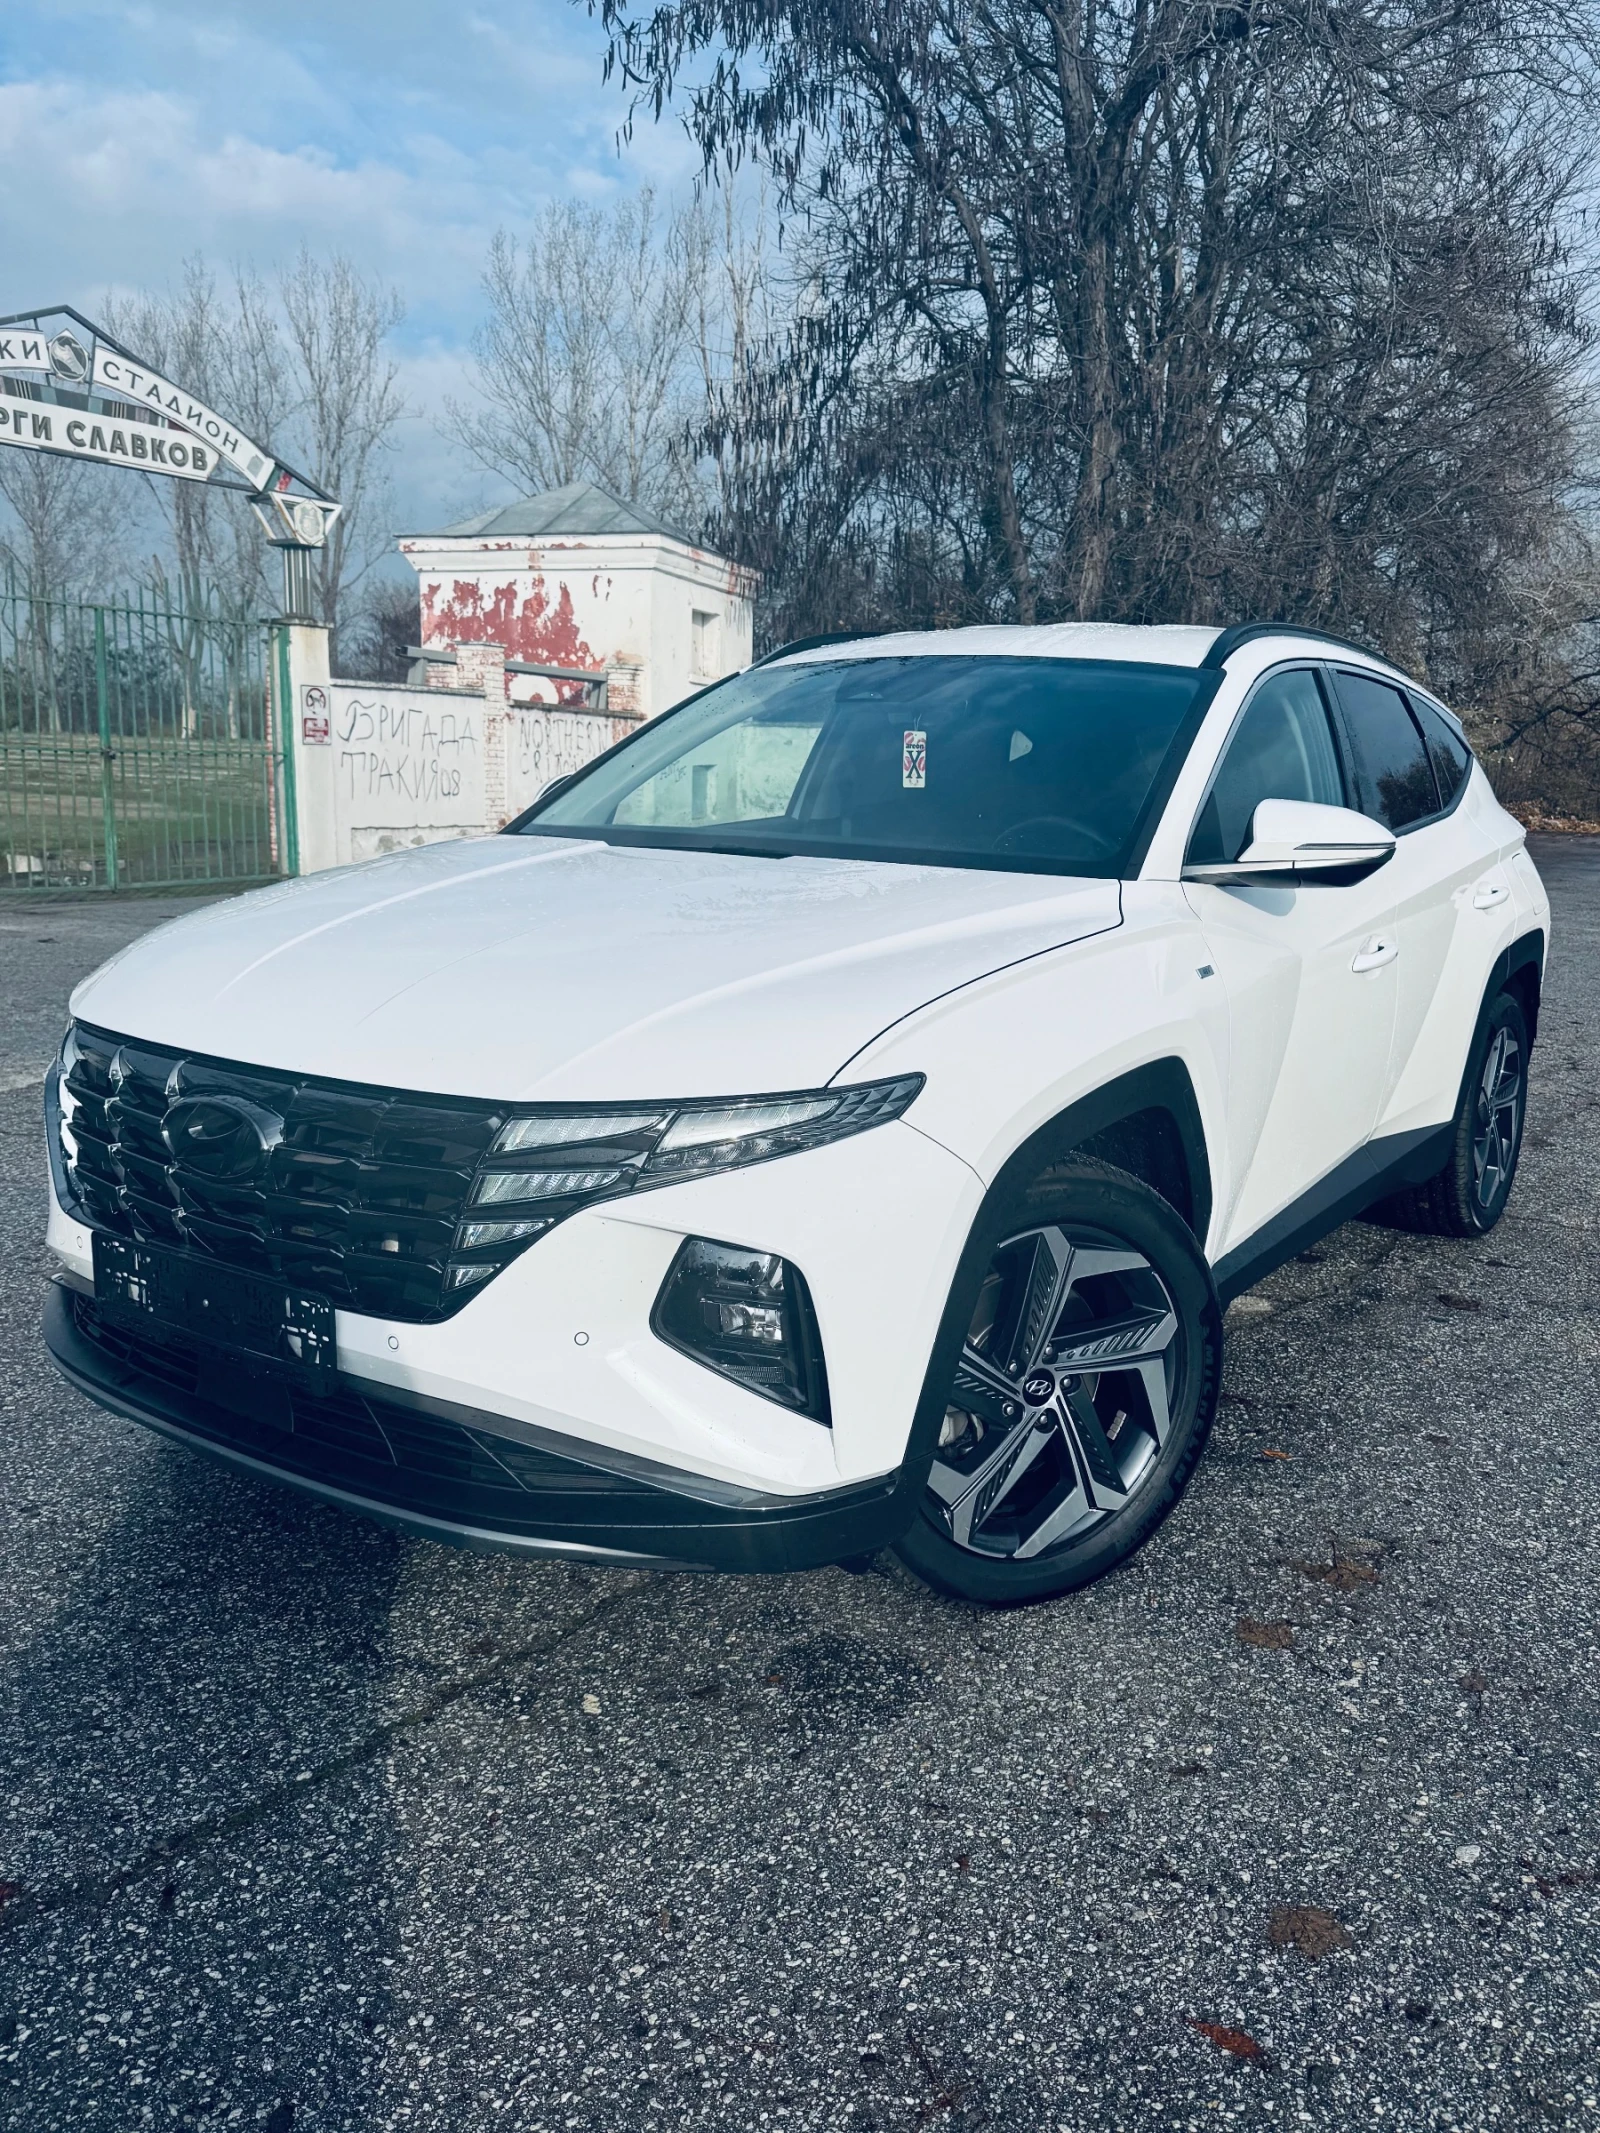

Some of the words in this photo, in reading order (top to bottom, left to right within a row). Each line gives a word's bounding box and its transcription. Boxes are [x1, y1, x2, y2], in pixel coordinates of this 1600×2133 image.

[102, 360, 240, 454] СТАДИОН
[66, 420, 208, 471] СЛАВКОВ
[336, 700, 479, 757] БРИГАДА
[905, 750, 924, 779] X
[1173, 1343, 1214, 1484] MICHELIN
